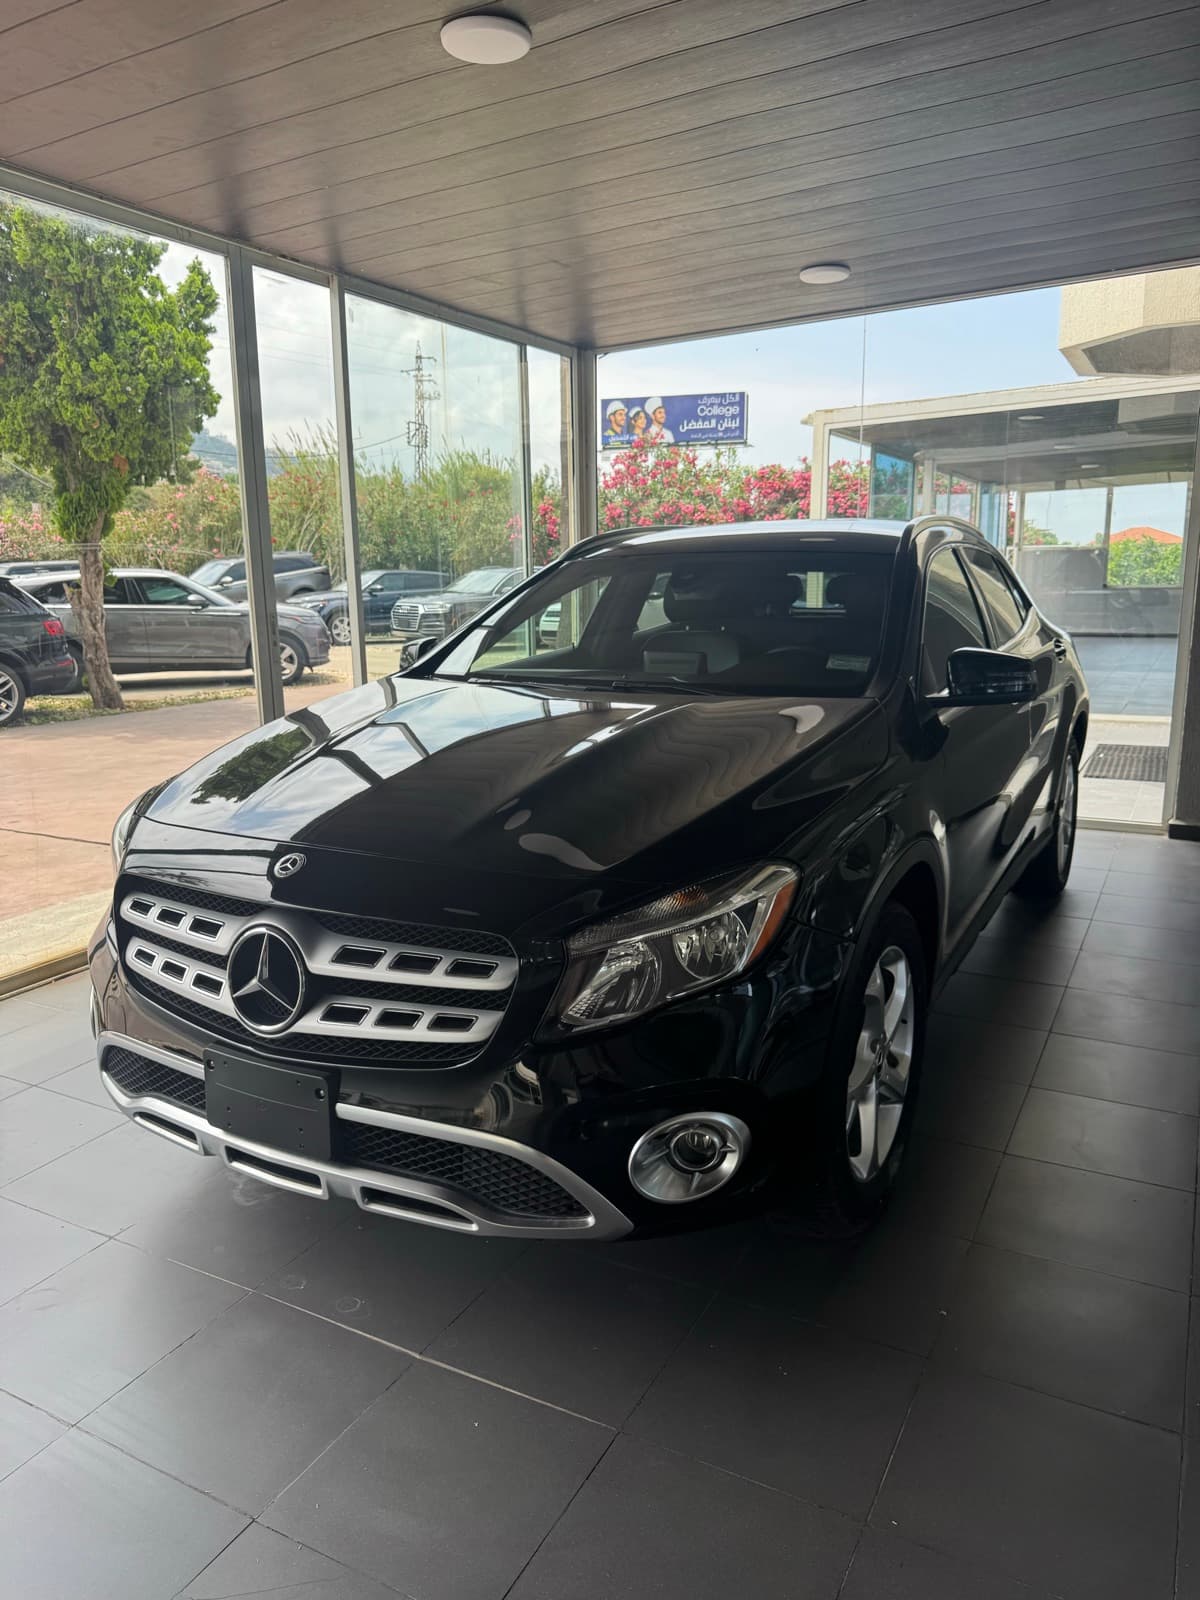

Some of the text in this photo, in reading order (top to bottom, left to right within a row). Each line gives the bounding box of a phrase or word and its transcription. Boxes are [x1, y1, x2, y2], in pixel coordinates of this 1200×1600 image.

[697, 404, 740, 417] College
[679, 417, 740, 433] لبنان المفضل
